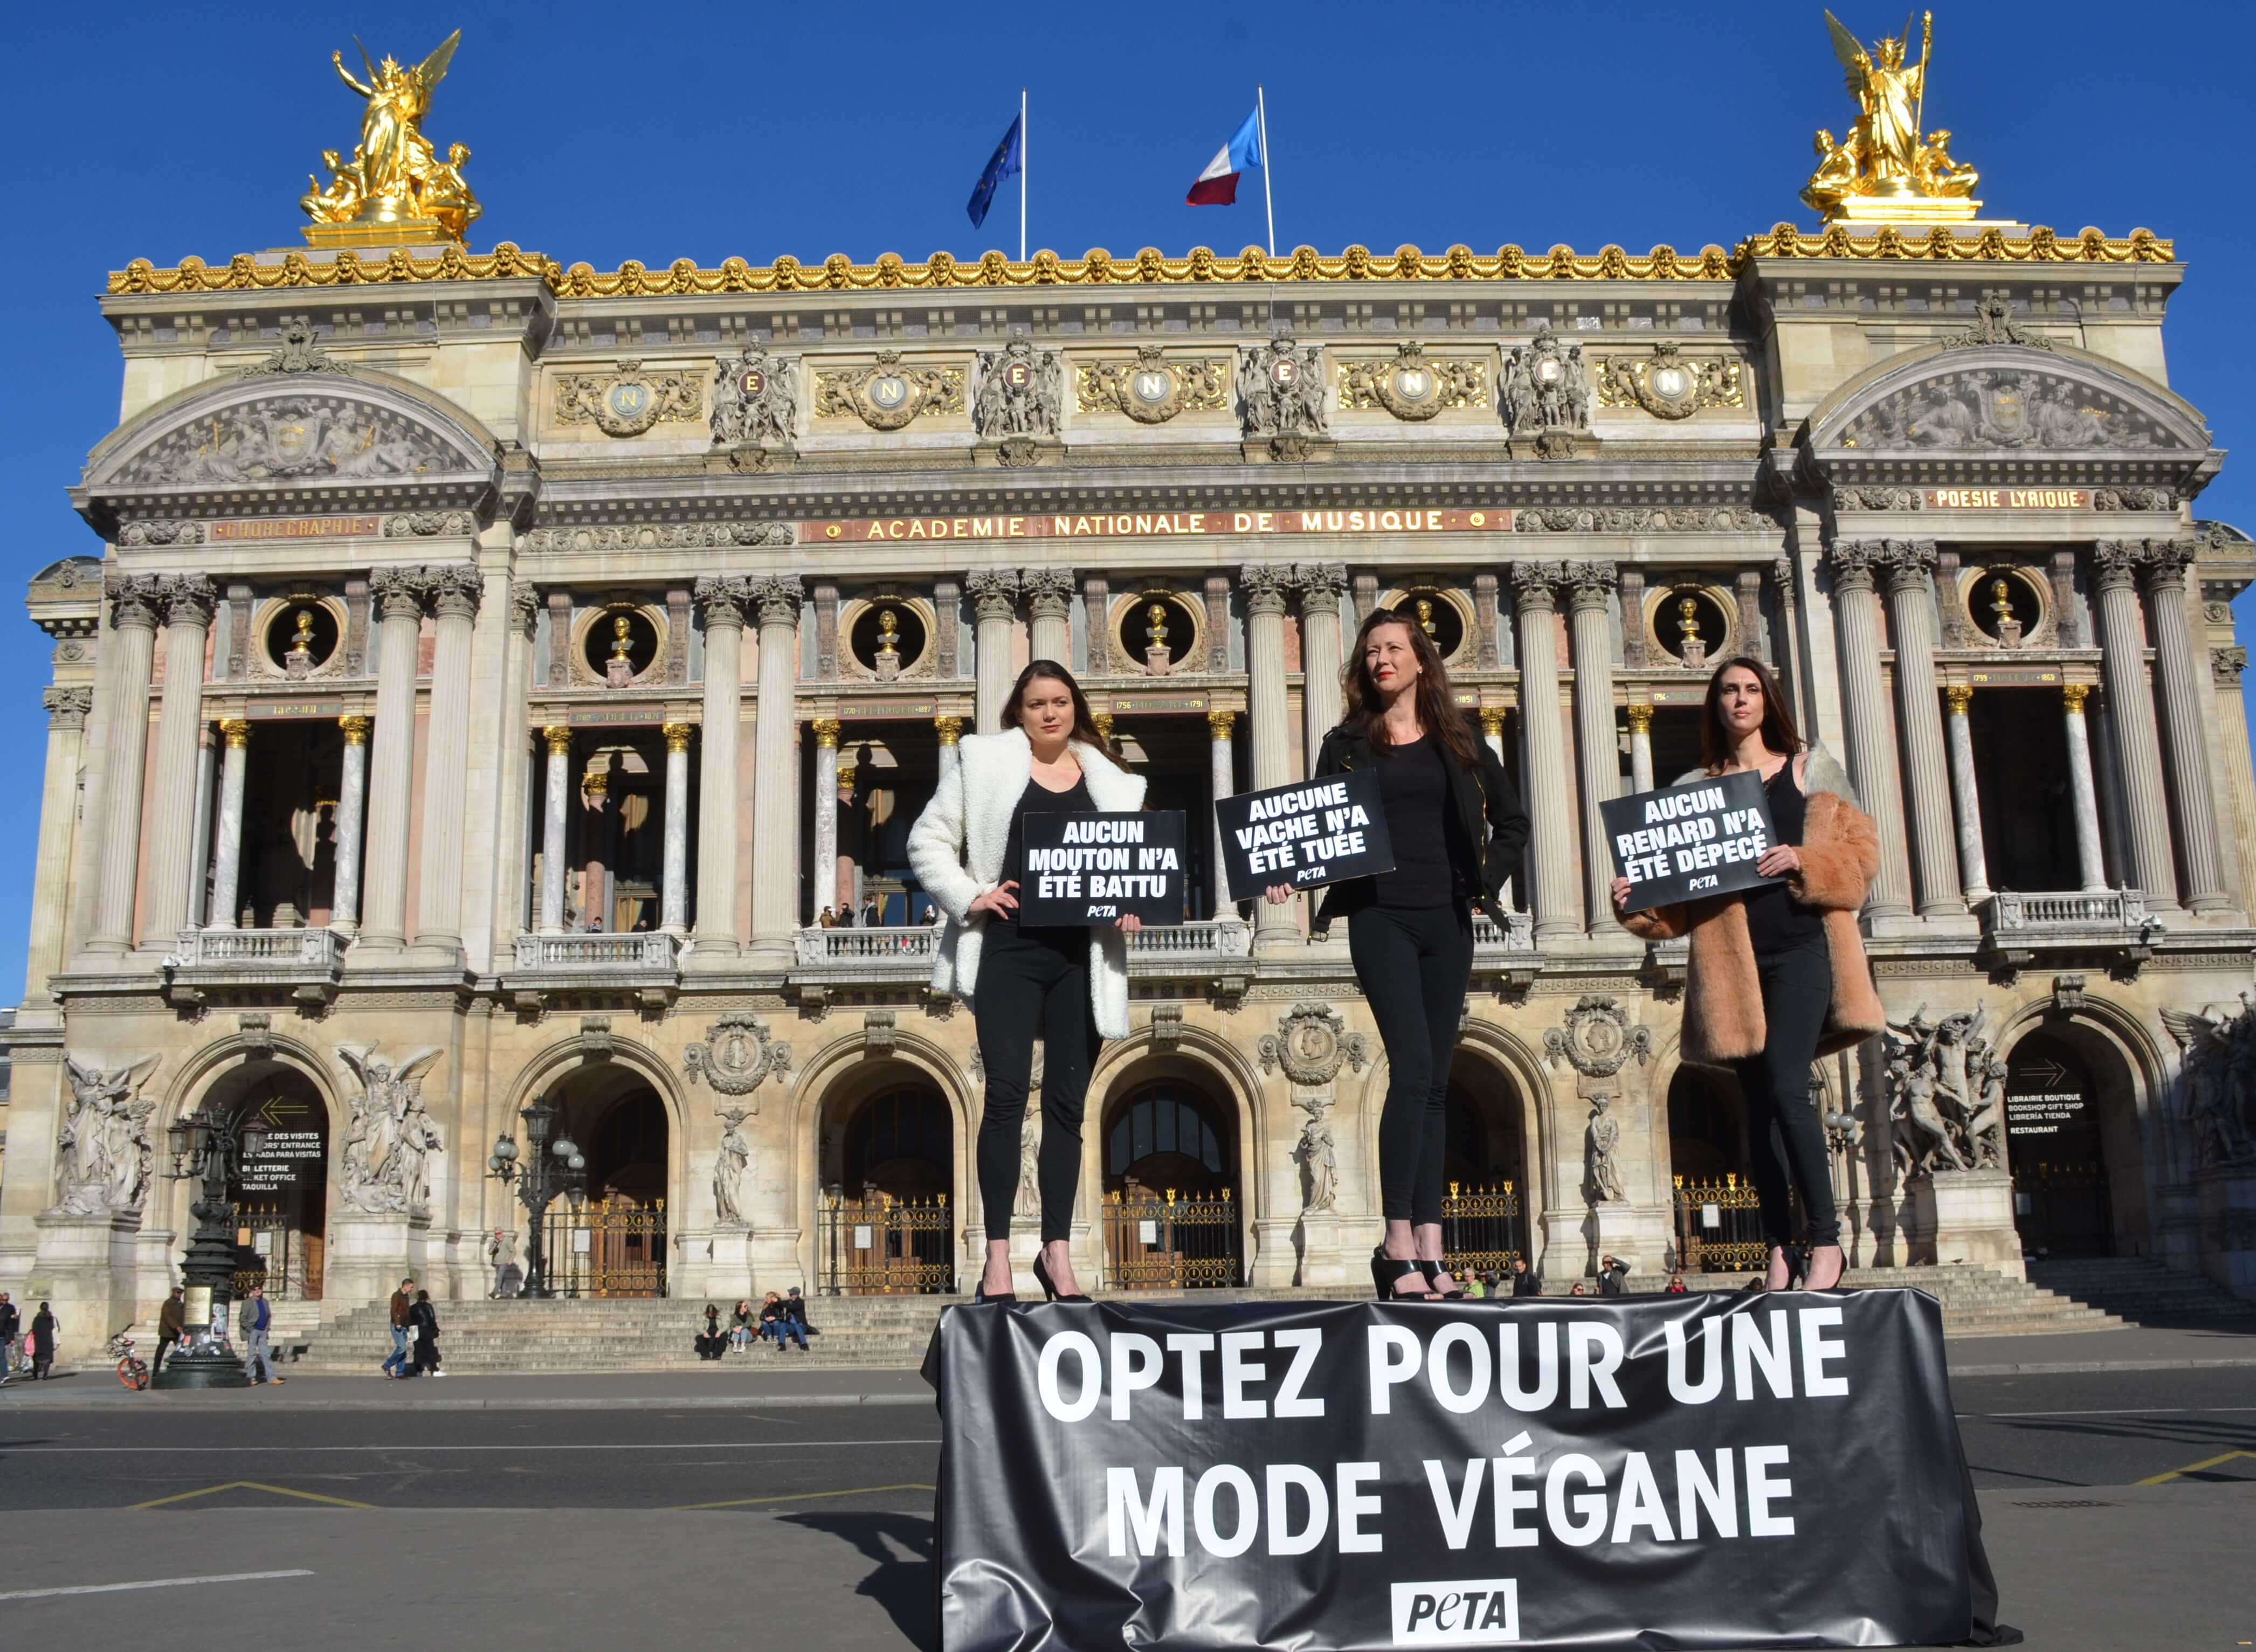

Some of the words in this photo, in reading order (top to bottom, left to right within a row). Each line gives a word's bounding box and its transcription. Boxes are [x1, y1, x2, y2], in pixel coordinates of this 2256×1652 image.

[1012, 368, 1025, 383] E
[1278, 365, 1291, 381] E
[1542, 363, 1555, 379] E
[746, 376, 758, 391] E
[880, 382, 897, 399] N
[1143, 376, 1160, 393] N
[1404, 374, 1422, 391] N
[1661, 372, 1679, 391] N
[620, 391, 637, 407] N
[1936, 490, 2000, 507] POESIE
[2009, 491, 2080, 508] LYRIQUE
[226, 517, 363, 538] CHOREGRAPHIE
[867, 517, 1024, 539] ACADEMIE
[1055, 514, 1205, 535] NATIONALE
[1234, 513, 1273, 532] DE
[1302, 510, 1443, 531] MUSIQUE
[1249, 782, 1349, 822] AUCUNE
[1645, 787, 1726, 824] AUCUN
[1062, 821, 1144, 844] AUCUN
[1235, 814, 1319, 850] VACHE
[1325, 805, 1370, 832] N'A
[1616, 817, 1716, 858] RENARD
[1722, 807, 1765, 835] N'A
[1029, 848, 1130, 871] MOUTON
[1139, 848, 1179, 870] N'A
[1248, 840, 1296, 875] ÉTÉ
[1300, 830, 1367, 863] TUÉE
[1624, 849, 1671, 884] ÉTÉ
[1675, 830, 1768, 873] DÉPECÉ
[1038, 870, 1081, 898] ÉTÉ
[1090, 875, 1167, 898] BATTU
[2007, 1095, 2044, 1103] LIBRAIRIE
[2009, 1112, 2043, 1121] LIBRERÍA
[2010, 1126, 2059, 1134] RESTAURANT
[1036, 1327, 1326, 1423] OPTEZ
[1368, 1322, 1629, 1415] POUR
[1664, 1306, 1850, 1405] UNE
[1105, 1461, 1383, 1558] MODE
[1422, 1429, 1796, 1550] VÉGANE
